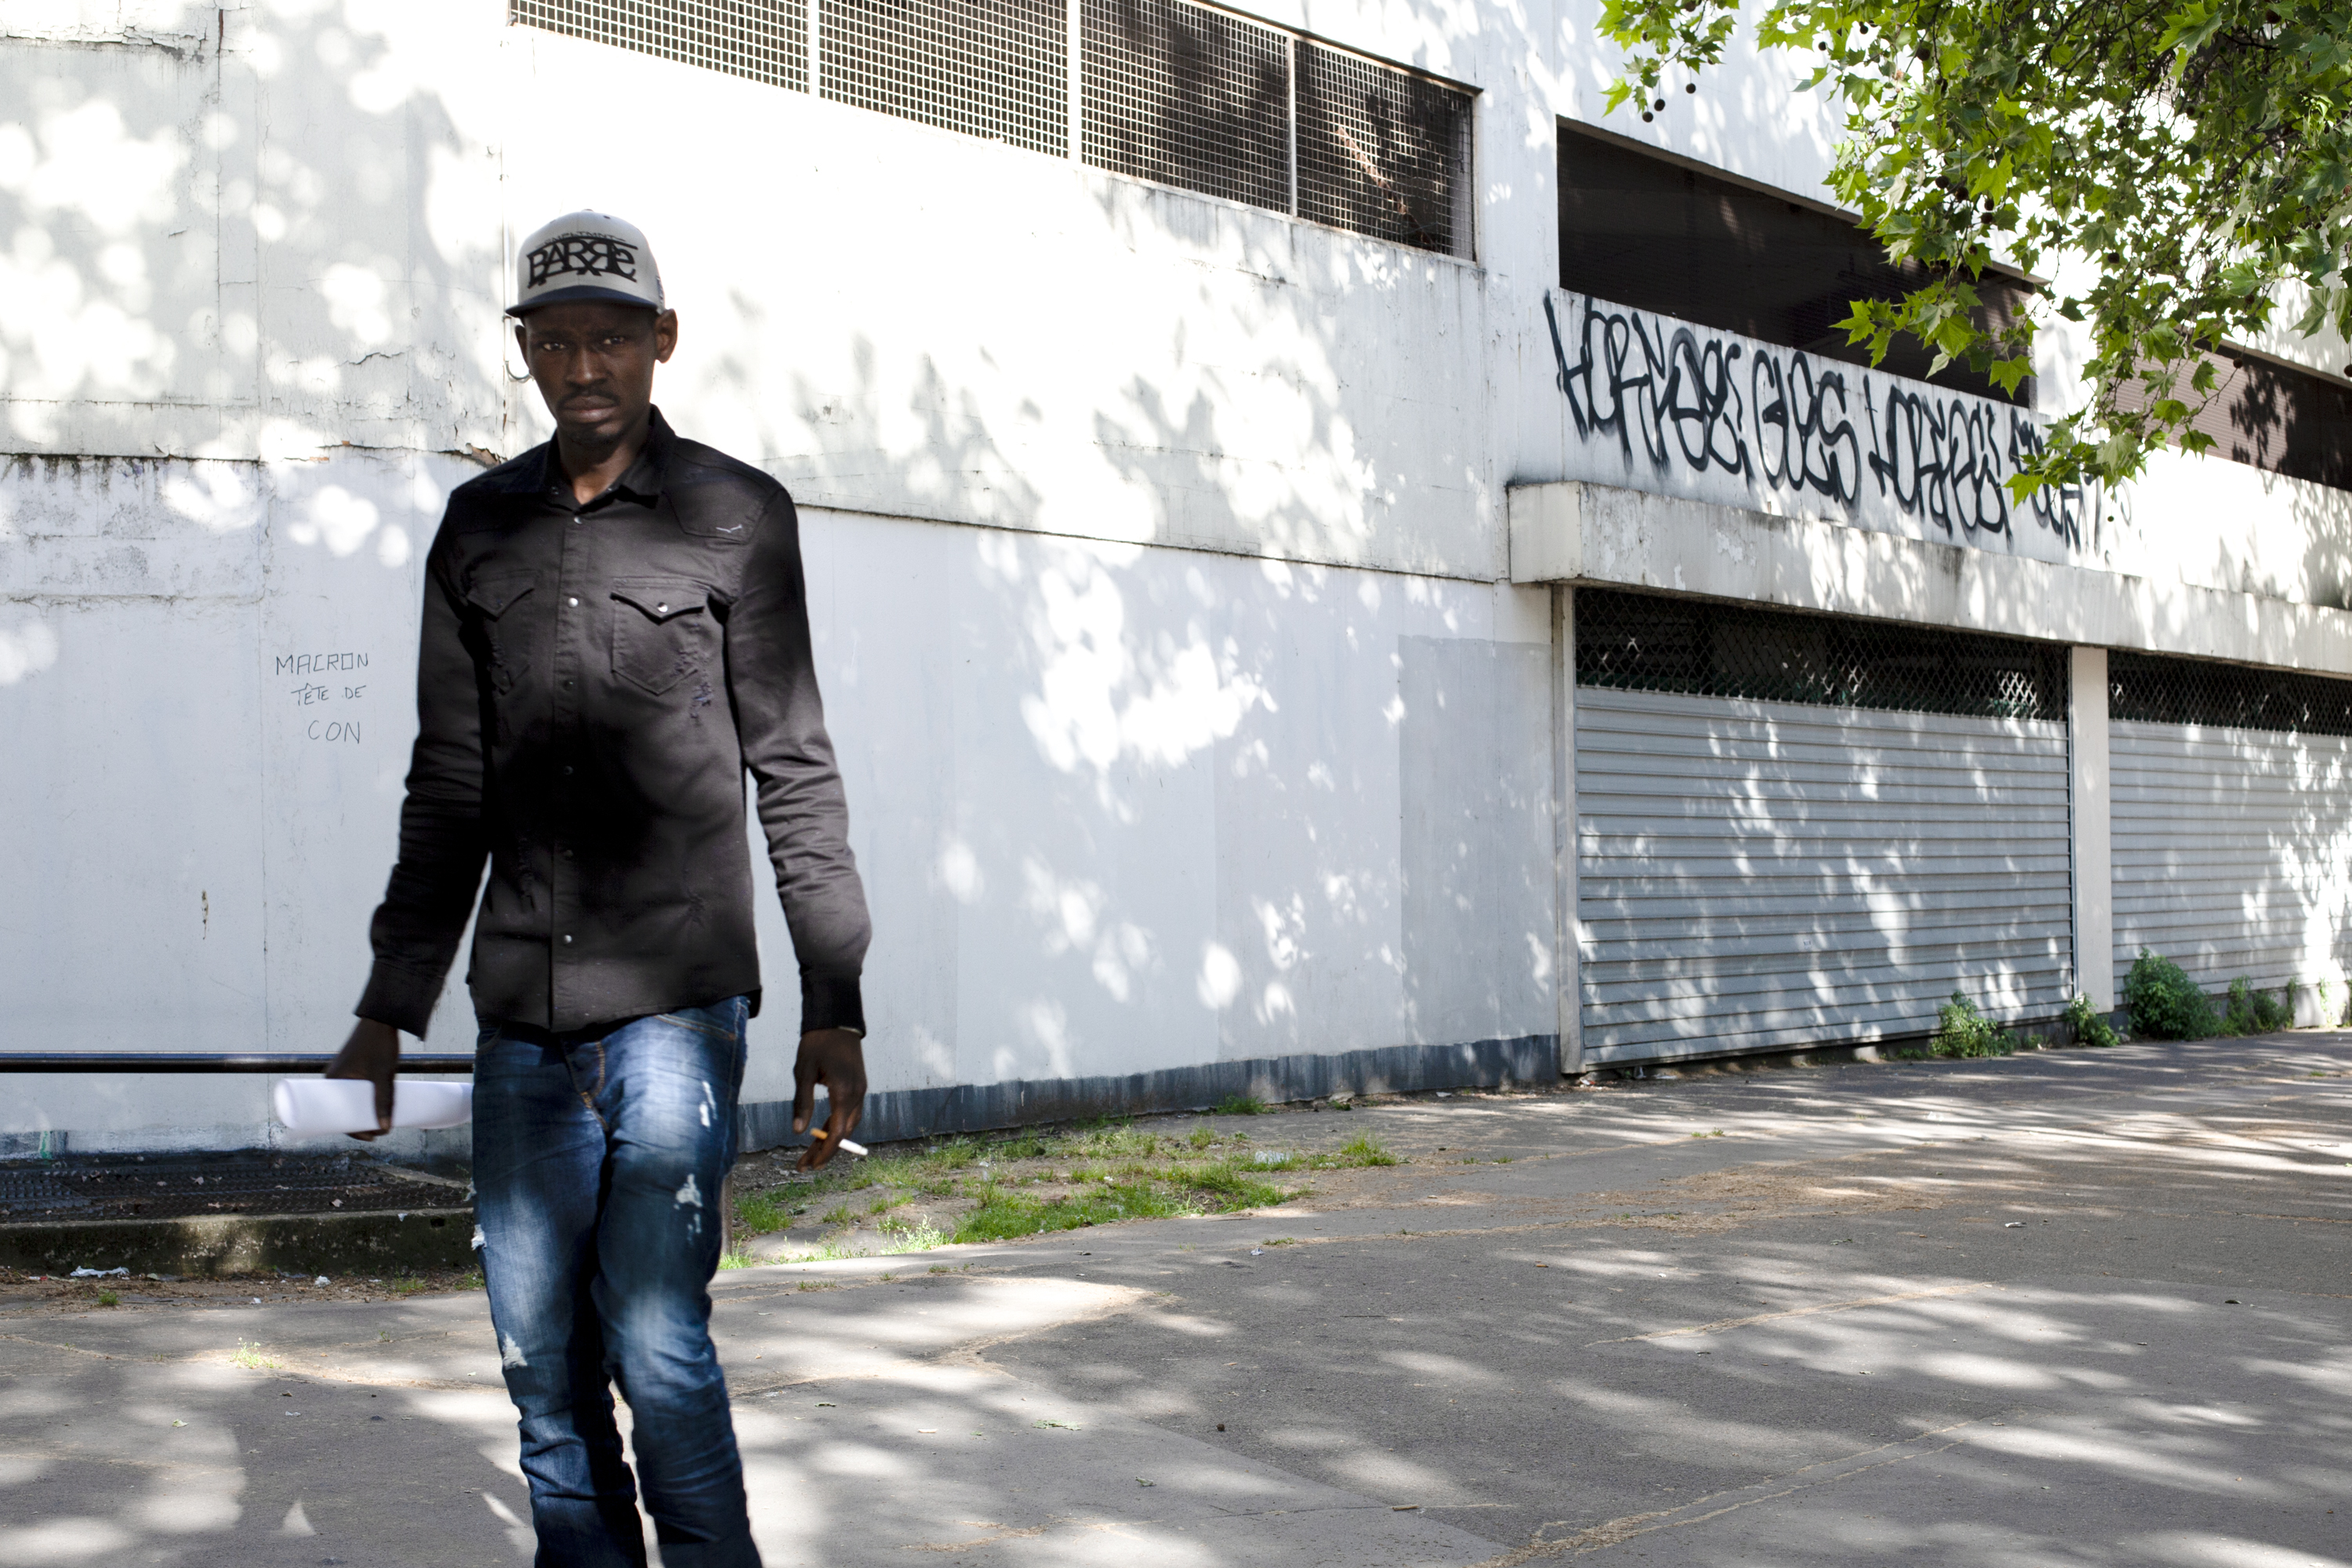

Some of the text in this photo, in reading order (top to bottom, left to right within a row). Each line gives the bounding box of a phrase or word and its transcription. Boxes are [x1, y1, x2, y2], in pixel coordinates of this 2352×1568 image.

[275, 652, 369, 676] MACRON
[290, 682, 367, 706] TÊTE DE
[307, 720, 361, 744] CON
